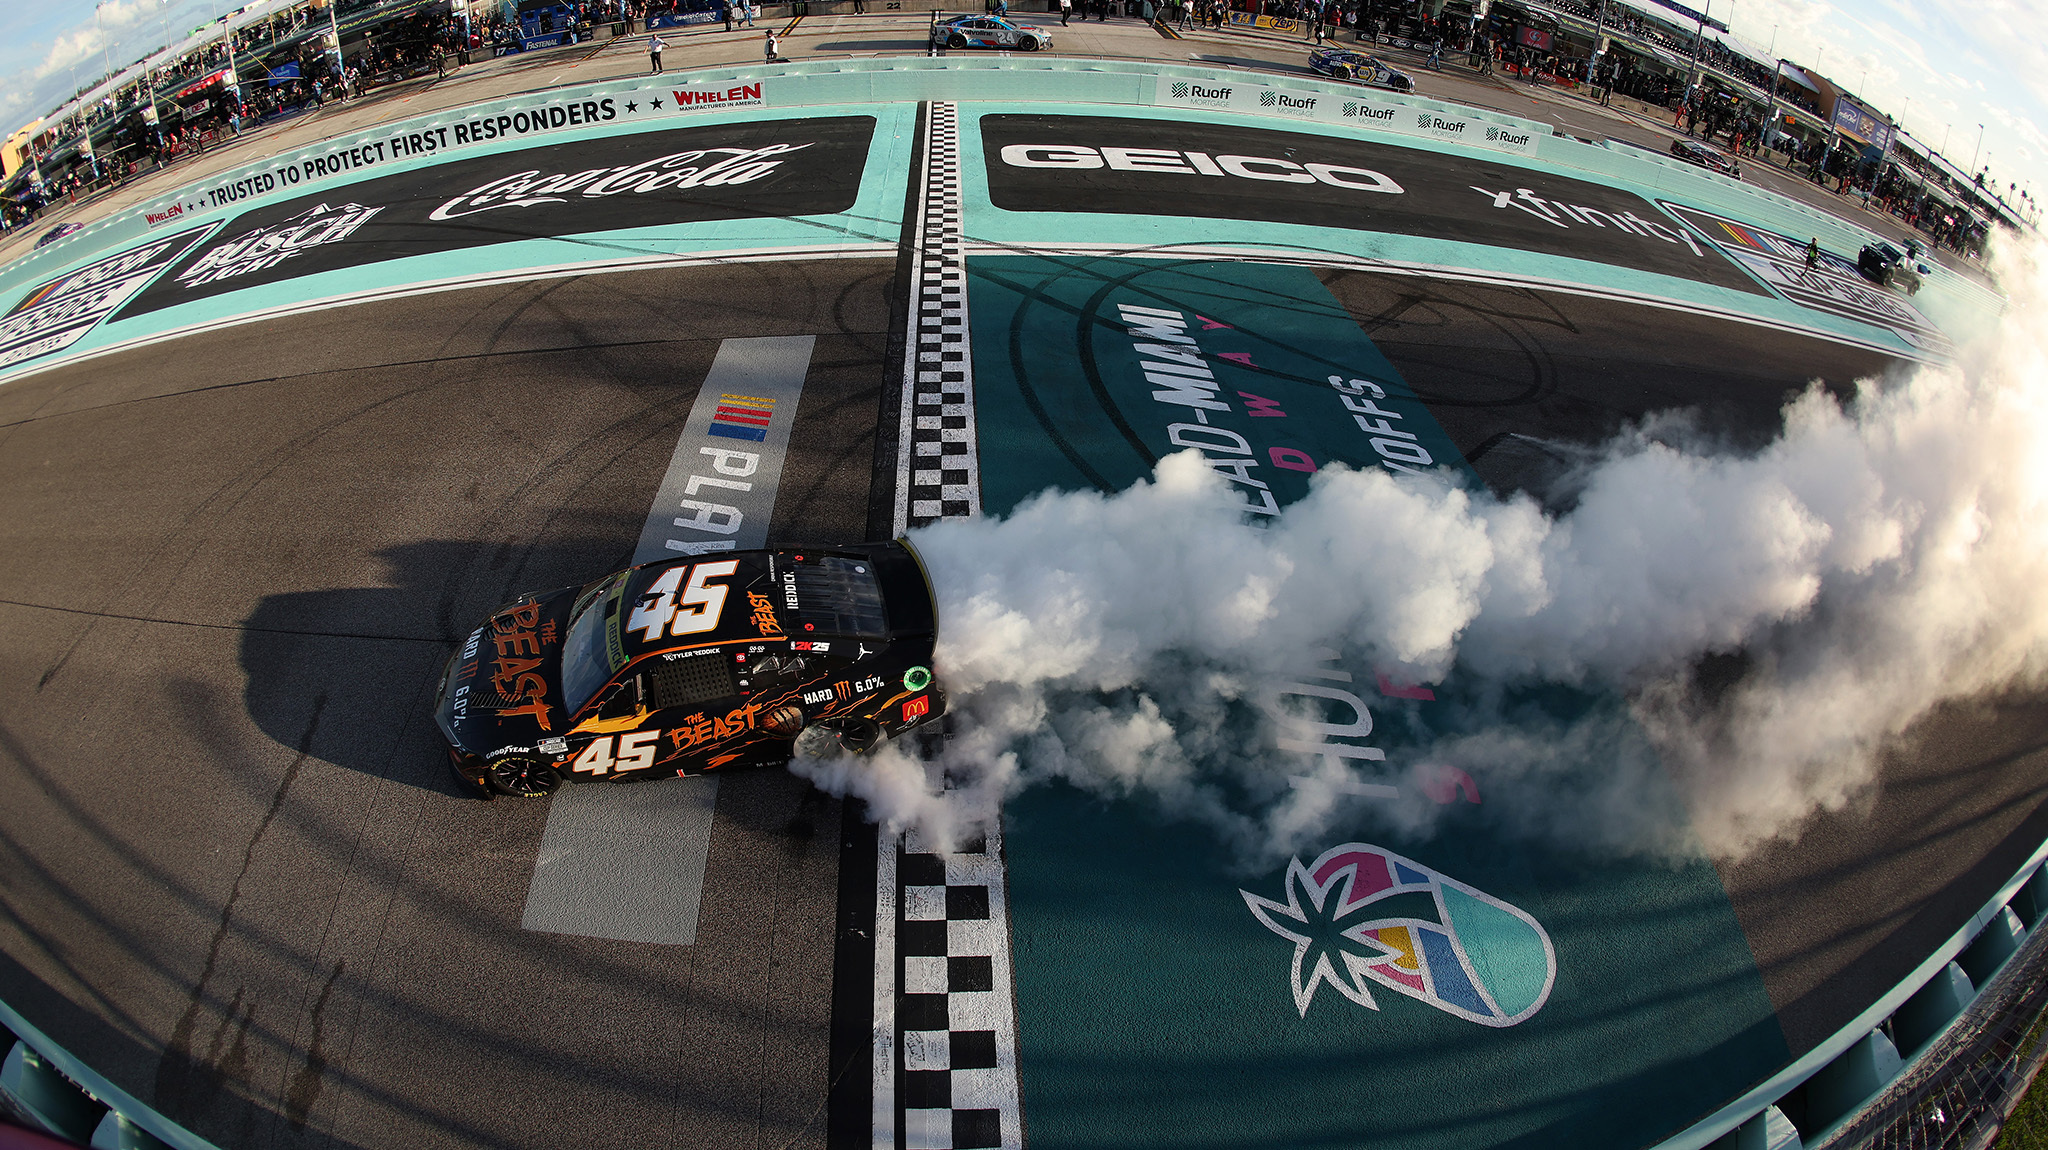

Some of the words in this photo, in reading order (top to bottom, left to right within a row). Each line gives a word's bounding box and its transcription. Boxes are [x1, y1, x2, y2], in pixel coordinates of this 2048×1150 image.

[886, 2, 901, 10] 22
[650, 18, 661, 28] 5
[1237, 13, 1251, 24] 14
[960, 29, 993, 37] Valvoline
[997, 32, 1016, 45] 24
[496, 47, 507, 57] 17
[526, 39, 558, 51] FASTENAL
[393, 73, 403, 81] 3
[1376, 72, 1391, 83] 9
[1191, 85, 1232, 100] Ruoff
[192, 101, 207, 113] DEX
[679, 103, 727, 111] MANUFACTURED
[1190, 98, 1230, 108] MORTGAGE
[1278, 94, 1317, 110] Ruoff
[1277, 107, 1315, 118] MORTGAGE
[1360, 105, 1395, 121] Ruoff
[1433, 118, 1466, 133] Ruoff
[1499, 131, 1530, 146] Ruoff
[208, 174, 276, 207] TRUSTED
[277, 167, 300, 185] TO
[304, 142, 386, 180] PROTECT
[390, 127, 448, 162] FIRST
[455, 97, 618, 144] RESPONDERS
[1001, 144, 1405, 194] GEICO
[1469, 185, 1704, 258] xfinity
[180, 207, 385, 281] BUSCH
[187, 251, 302, 288] LIGHT
[626, 559, 740, 644] 45
[747, 591, 783, 637] BEAST
[541, 617, 557, 646] THE
[607, 620, 623, 670] REDDICK
[673, 651, 693, 660] TYLER
[694, 647, 720, 657] REDDICK
[489, 597, 554, 732] BEAST
[803, 688, 833, 705] HARD
[855, 676, 885, 693] 6.0%
[452, 685, 471, 728] 6.0%
[671, 704, 763, 749] BEAST
[684, 713, 705, 726] THE
[485, 744, 530, 760] GOODYEAR
[572, 728, 662, 776] 45
